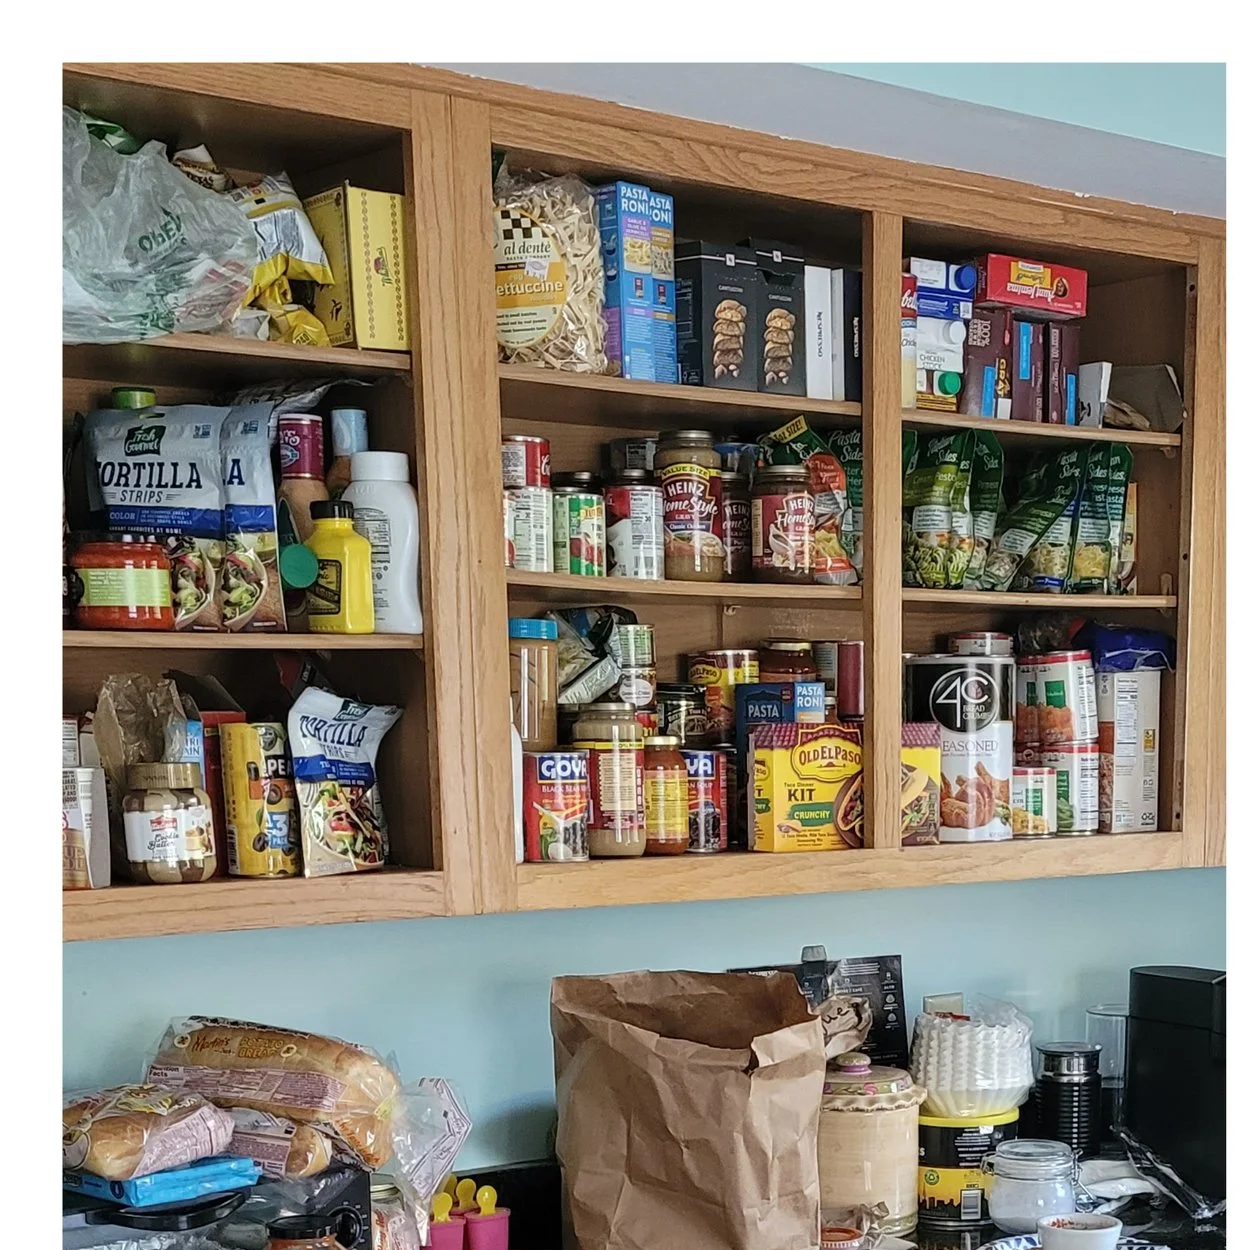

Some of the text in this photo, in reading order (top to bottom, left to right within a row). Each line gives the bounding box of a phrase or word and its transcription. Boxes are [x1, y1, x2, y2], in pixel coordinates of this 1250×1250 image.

[621, 186, 649, 201] PASTA
[621, 198, 649, 215] RONI
[650, 196, 671, 211] ASTA
[650, 209, 672, 224] ONI
[504, 241, 516, 256] al
[496, 281, 564, 296] ettuccine
[816, 311, 824, 358] NESPRESSO
[852, 316, 860, 358] NESPRESSO
[919, 353, 946, 363] CHICKEN
[996, 357, 1007, 397] GRAT
[828, 428, 861, 448] Pasta
[662, 465, 708, 477] VALUE SIZE
[1089, 463, 1107, 479] Sides
[120, 489, 164, 503] STRIPS
[668, 481, 705, 497] HEINZ
[724, 504, 751, 517] HEINZ
[789, 498, 815, 511] HEINZ
[797, 686, 823, 696] PASTA
[797, 696, 823, 708] RONI
[935, 675, 989, 728] 4C
[748, 704, 780, 718] PASTA
[299, 715, 369, 749] TORTILLA
[942, 740, 999, 752] EASONED
[266, 758, 293, 777] PEA
[541, 759, 587, 779] GOYA
[684, 759, 713, 775] YA
[541, 784, 563, 793] BLACK
[787, 788, 816, 802] KIT
[793, 810, 831, 819] CRUNCHY
[273, 814, 289, 837] 3
[272, 836, 289, 845] PACK
[191, 1034, 232, 1052] Martin's
[238, 1036, 285, 1050] POTATO
